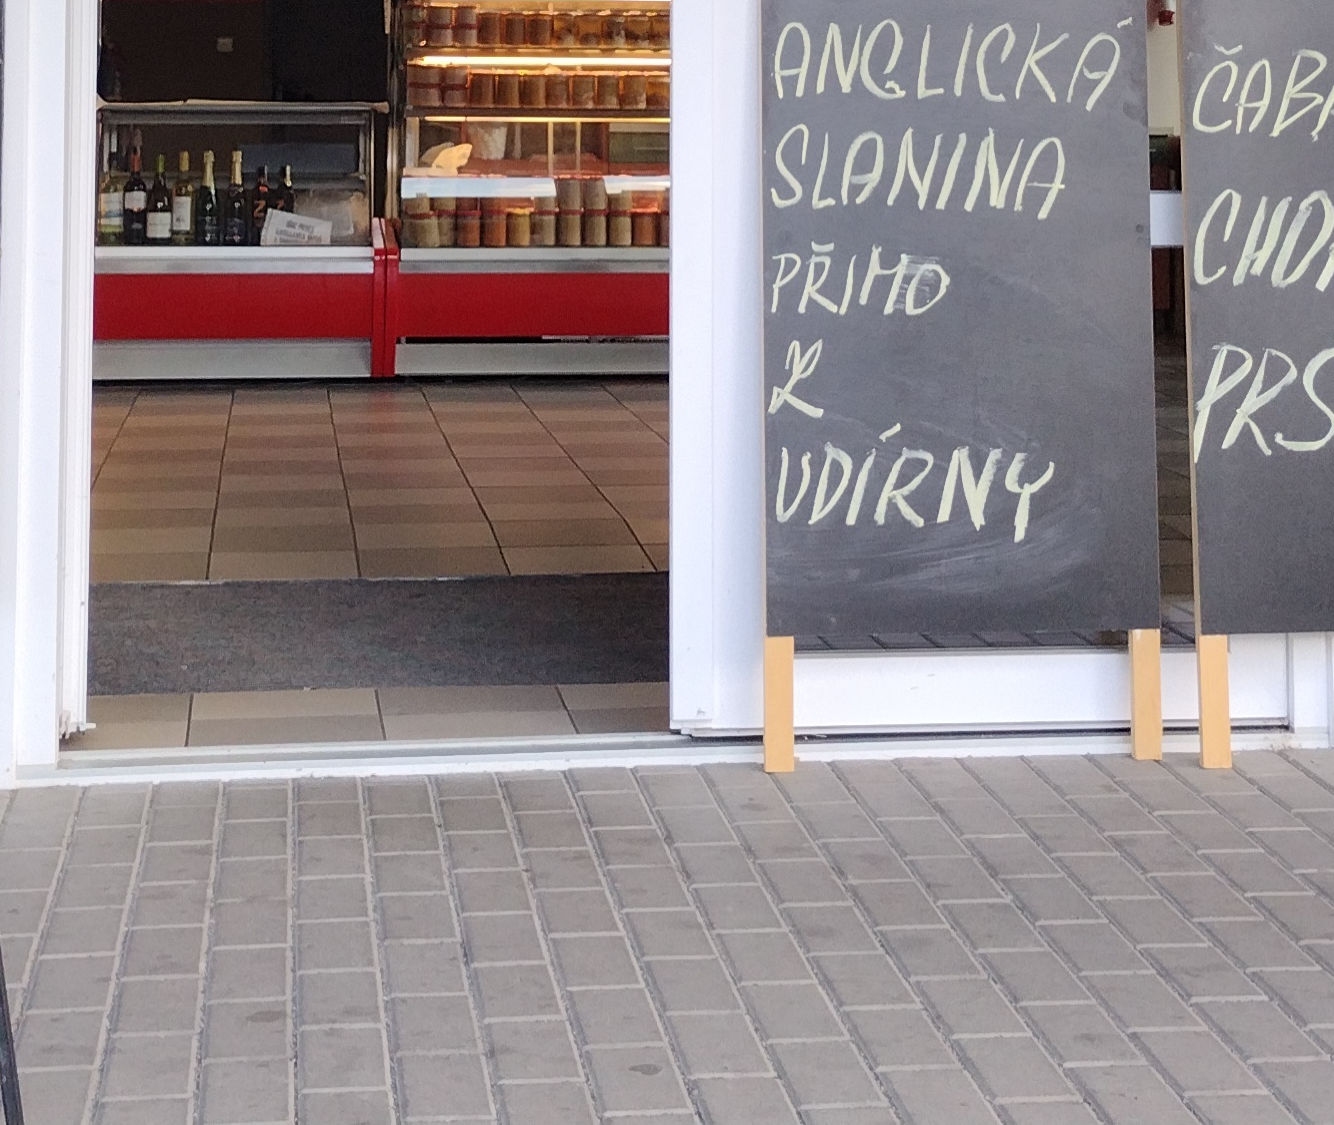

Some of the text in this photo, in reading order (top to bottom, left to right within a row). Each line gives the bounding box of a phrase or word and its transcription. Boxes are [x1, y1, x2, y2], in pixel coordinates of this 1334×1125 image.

[773, 16, 1134, 112] ANGLICKÁ
[770, 123, 1066, 220] SLANINA
[775, 422, 1056, 544] UDÍRNY
